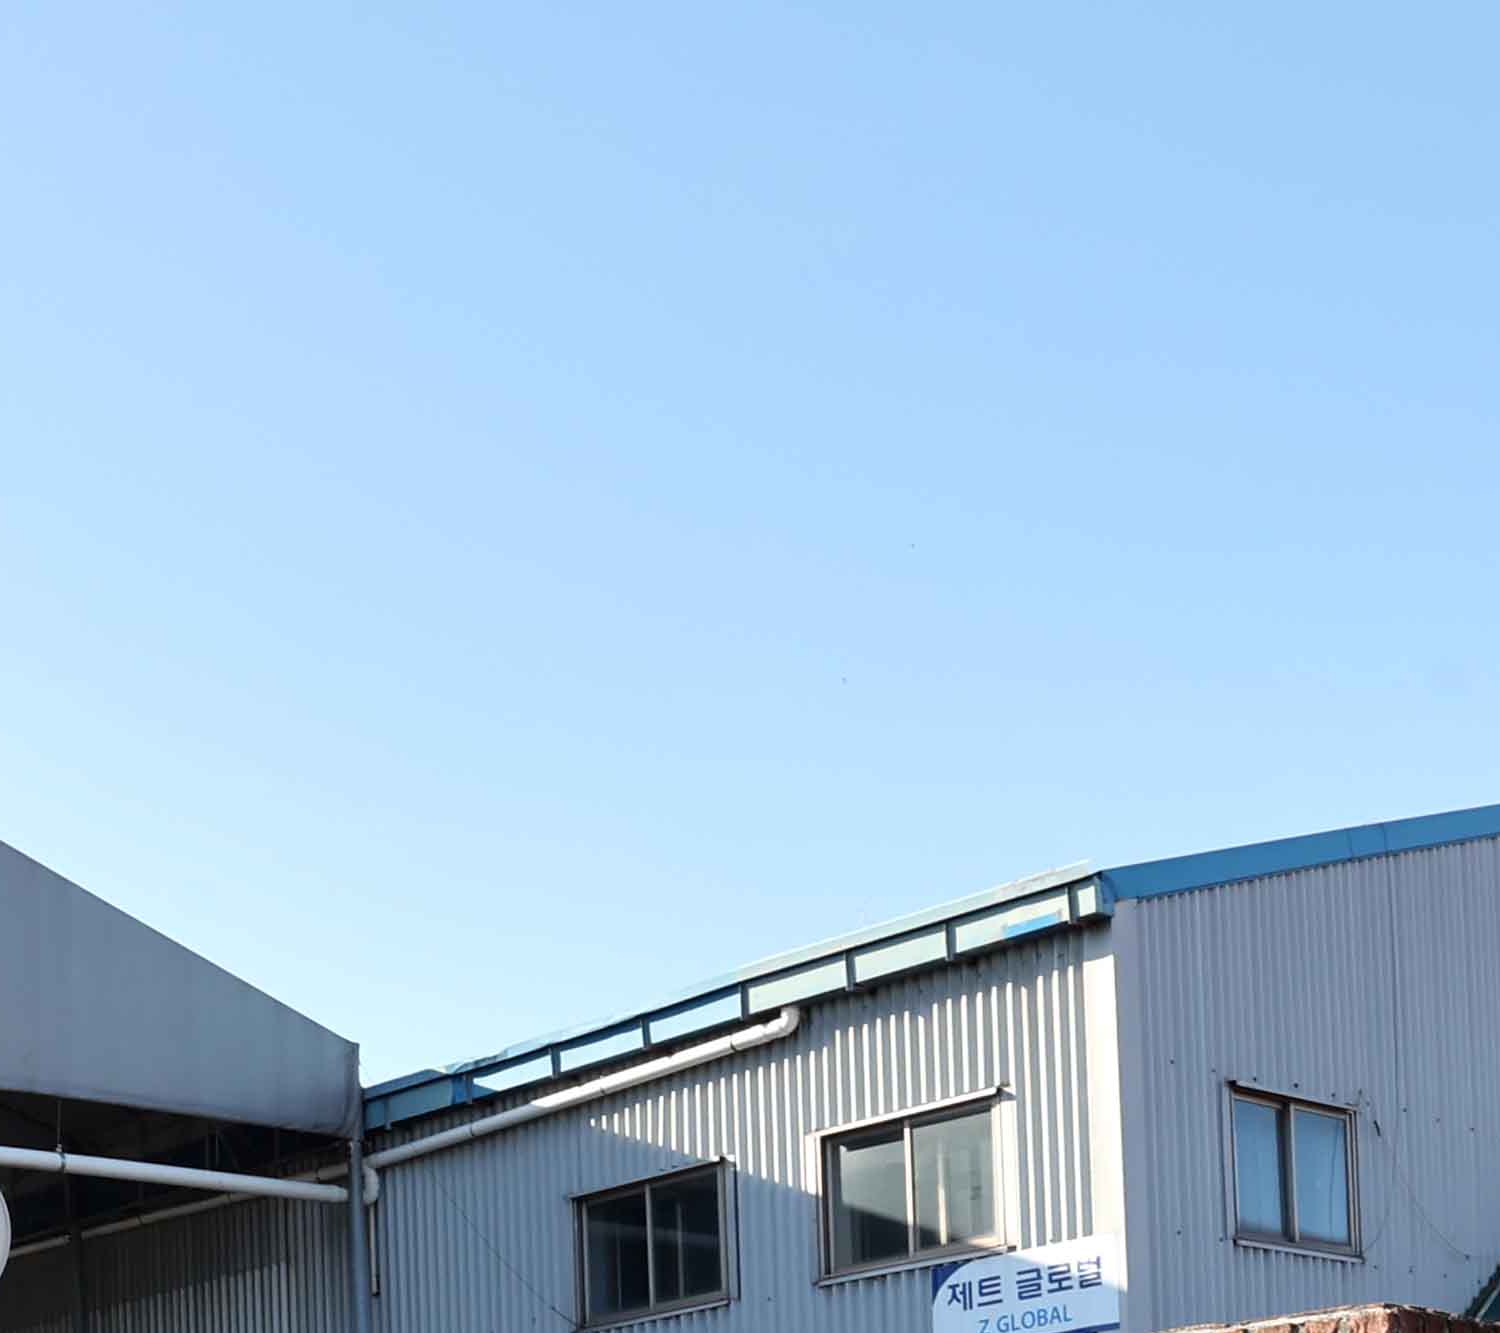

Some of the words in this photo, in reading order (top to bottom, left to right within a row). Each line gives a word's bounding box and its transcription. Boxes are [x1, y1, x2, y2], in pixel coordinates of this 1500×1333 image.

[947, 1275, 1003, 1311] 제트
[1016, 1256, 1103, 1300] 글로벌
[996, 1305, 1073, 1333] GLOBAL
